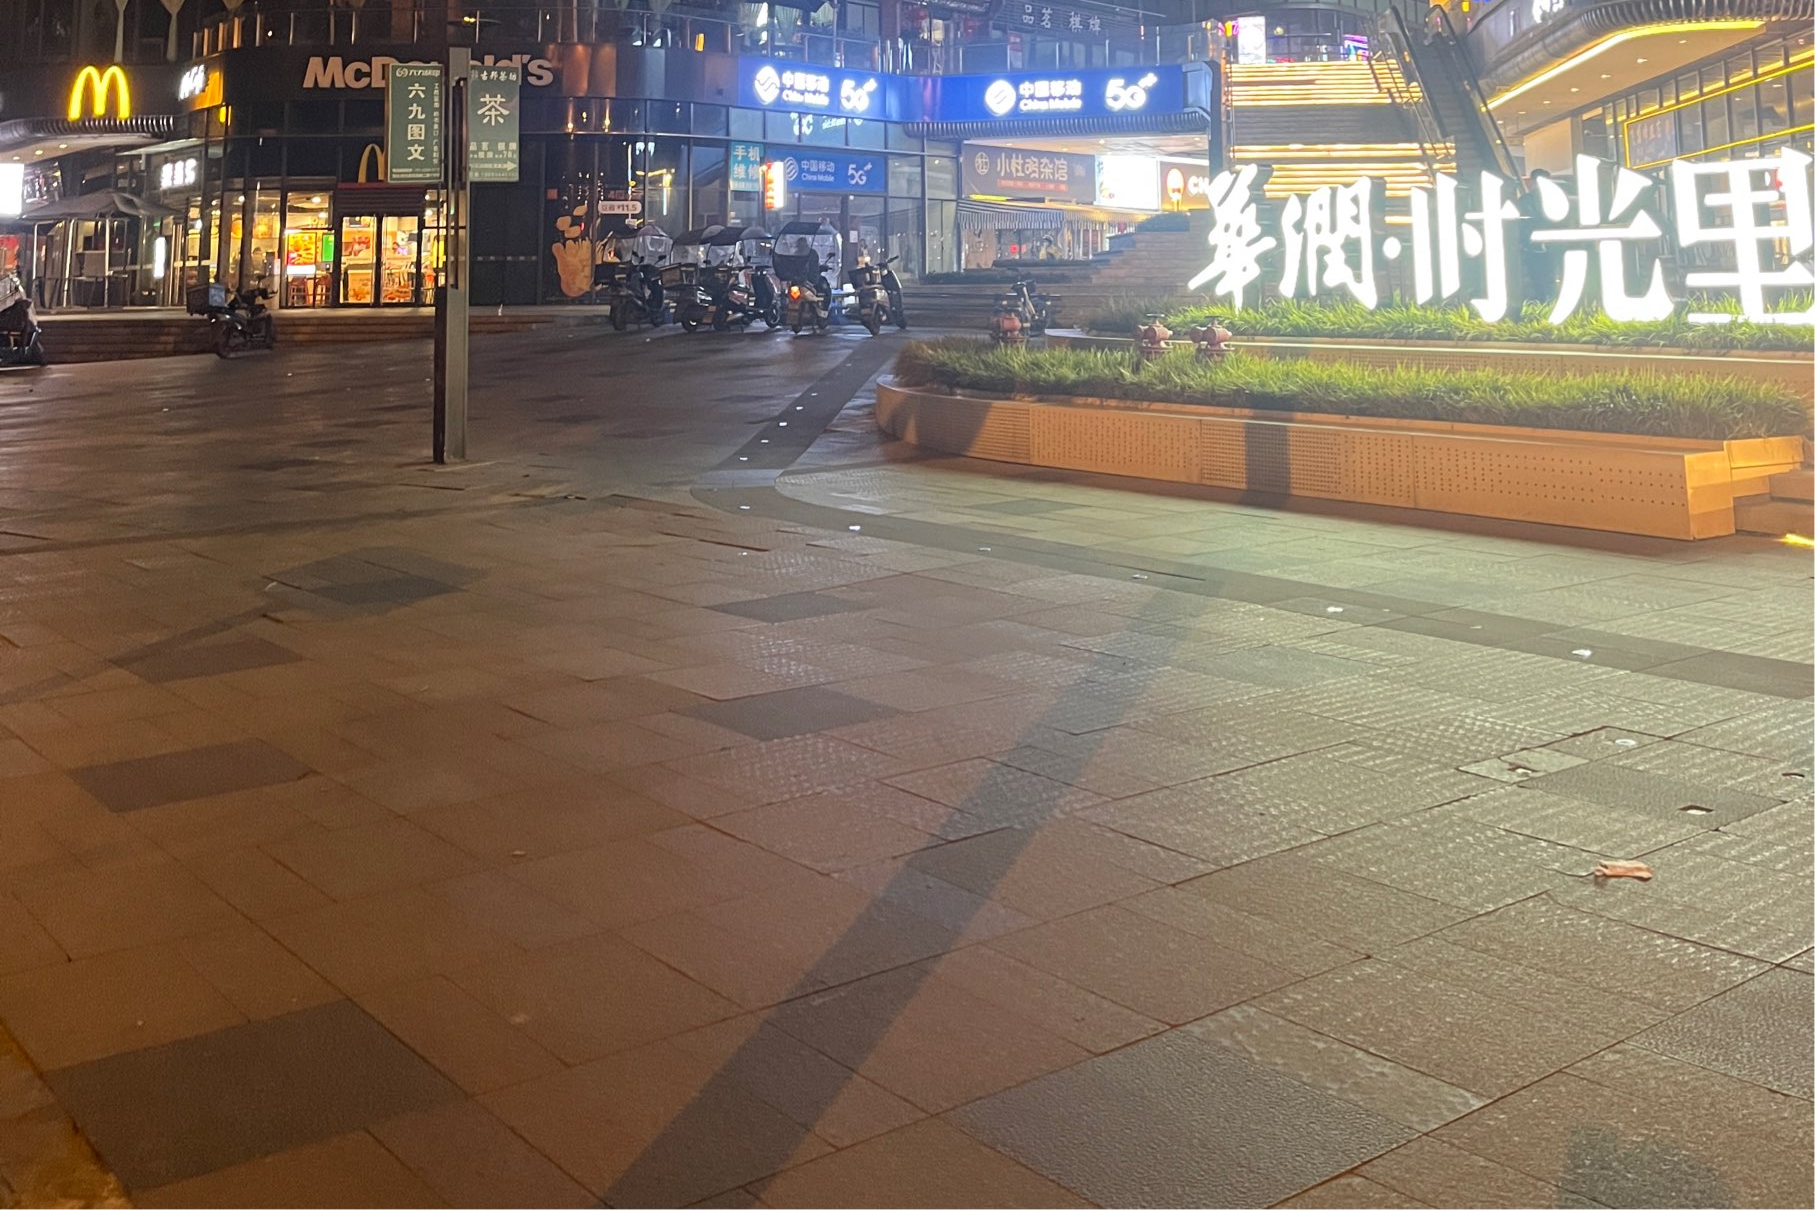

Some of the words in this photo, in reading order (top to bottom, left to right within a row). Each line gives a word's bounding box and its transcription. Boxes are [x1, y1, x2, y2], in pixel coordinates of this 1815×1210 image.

[1022, 4, 1053, 29] 品茗
[1068, 11, 1101, 34] 棋牌
[477, 94, 510, 126] 茶
[407, 83, 426, 161] 六九图文
[733, 145, 760, 162] 手机
[733, 164, 760, 180] 维修
[801, 160, 835, 173] 中国移动
[801, 173, 817, 181] China
[818, 174, 835, 182] Mobile
